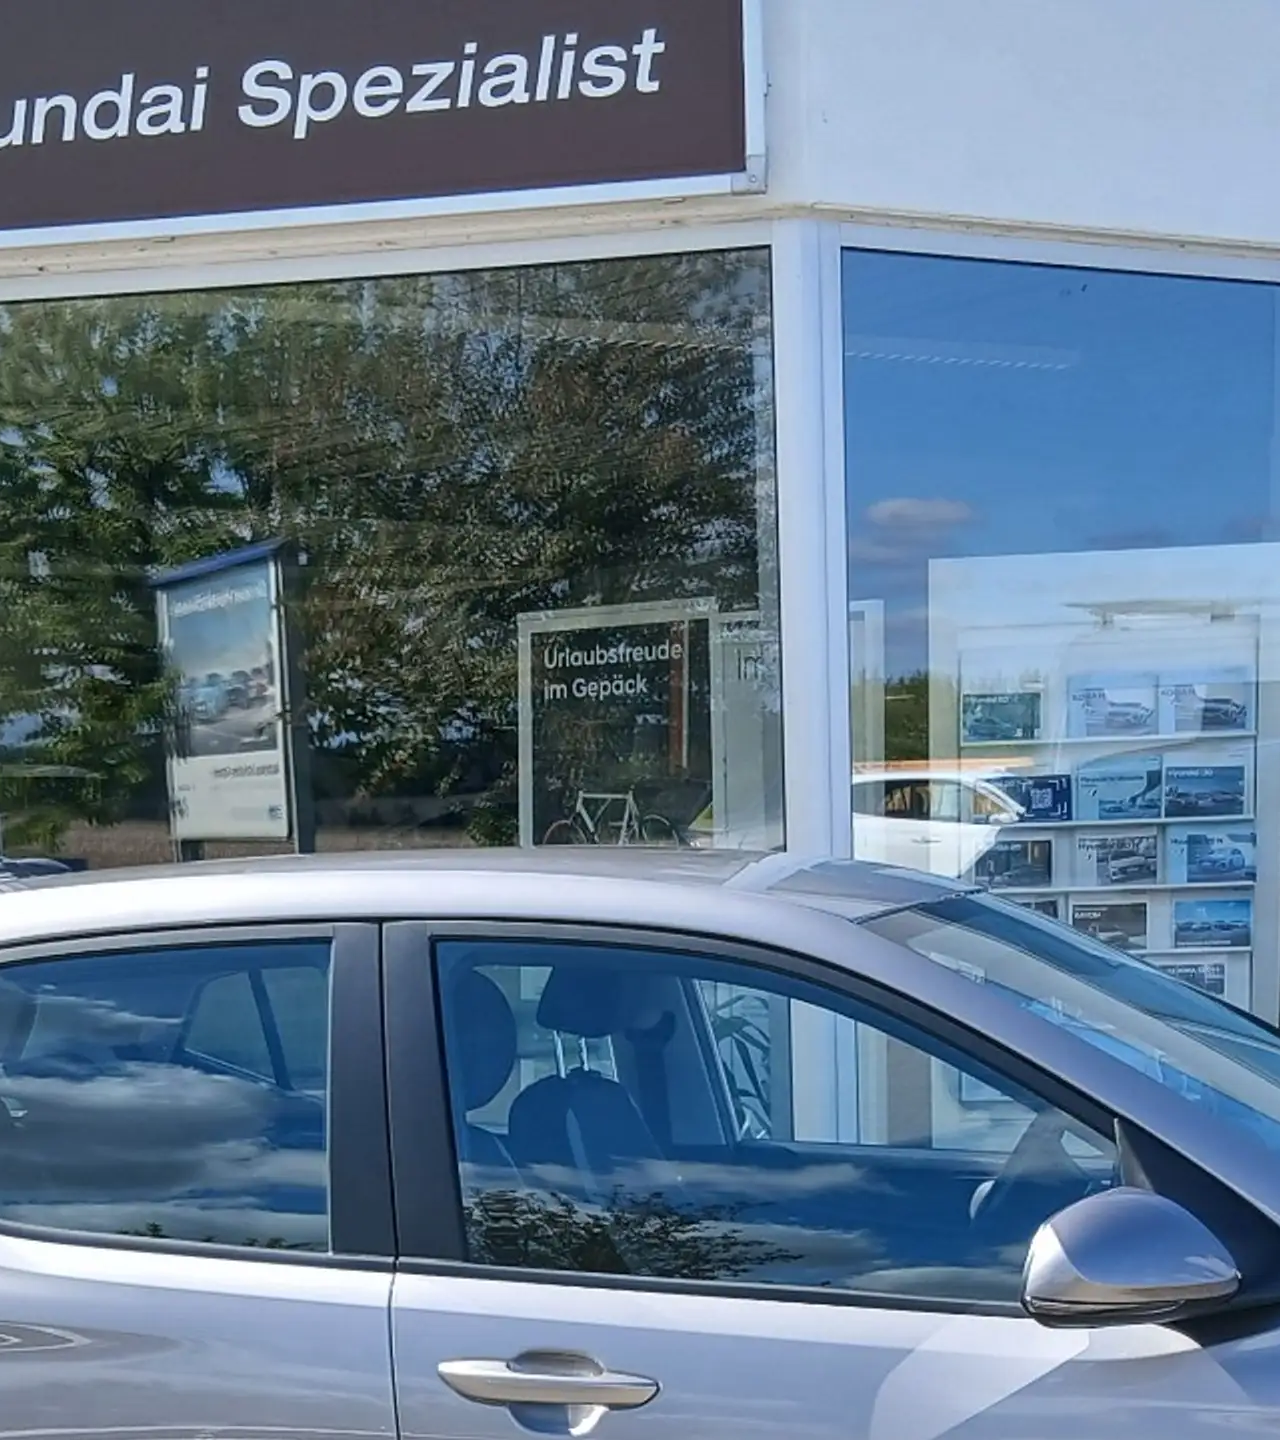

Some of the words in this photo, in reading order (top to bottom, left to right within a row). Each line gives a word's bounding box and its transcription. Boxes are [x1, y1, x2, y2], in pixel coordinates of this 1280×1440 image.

[237, 27, 666, 139] Spezialist
[543, 640, 683, 669] Urlaubsfreude
[543, 679, 568, 700] im
[572, 673, 648, 701] Gepäck
